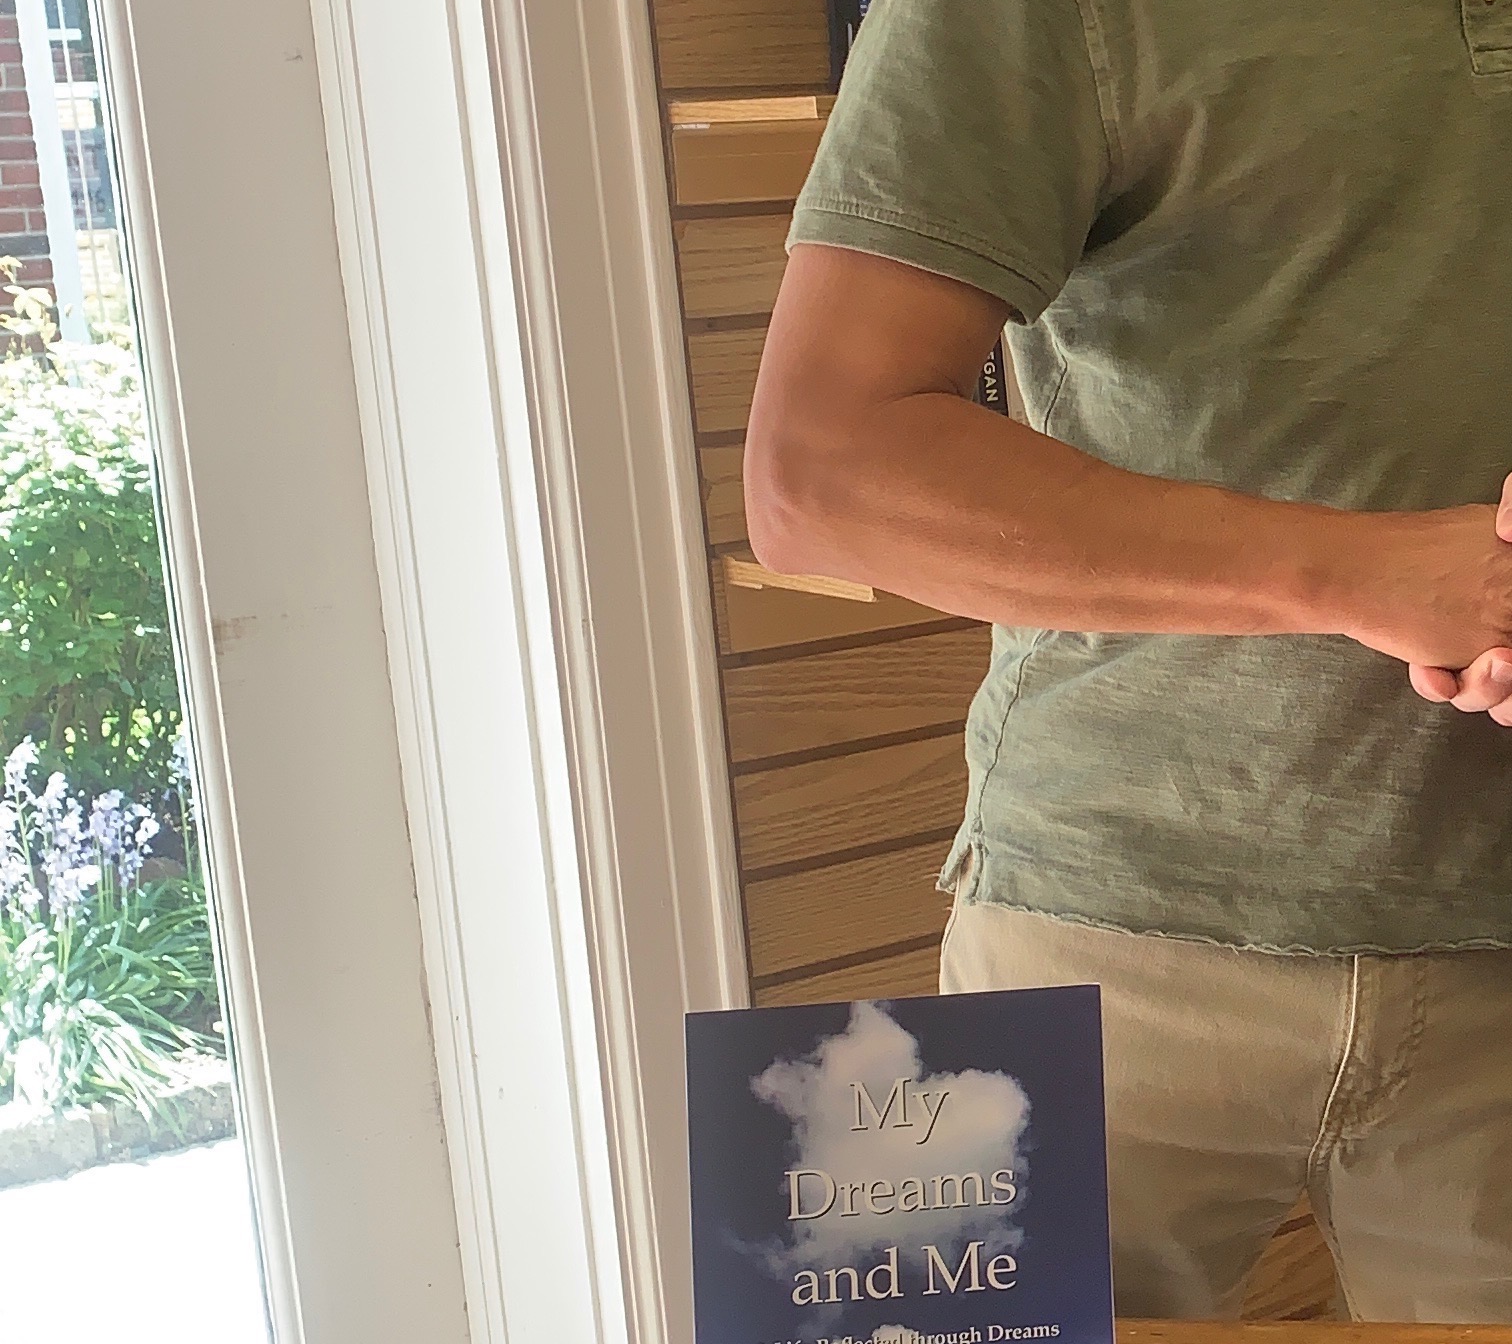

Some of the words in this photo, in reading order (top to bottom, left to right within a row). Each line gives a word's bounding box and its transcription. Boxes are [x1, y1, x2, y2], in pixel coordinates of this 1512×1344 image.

[850, 1076, 951, 1146] My
[785, 1165, 1019, 1222] Dreams
[791, 1247, 904, 1306] and
[920, 1240, 1018, 1297] Me
[987, 1321, 1061, 1341] Dreams
